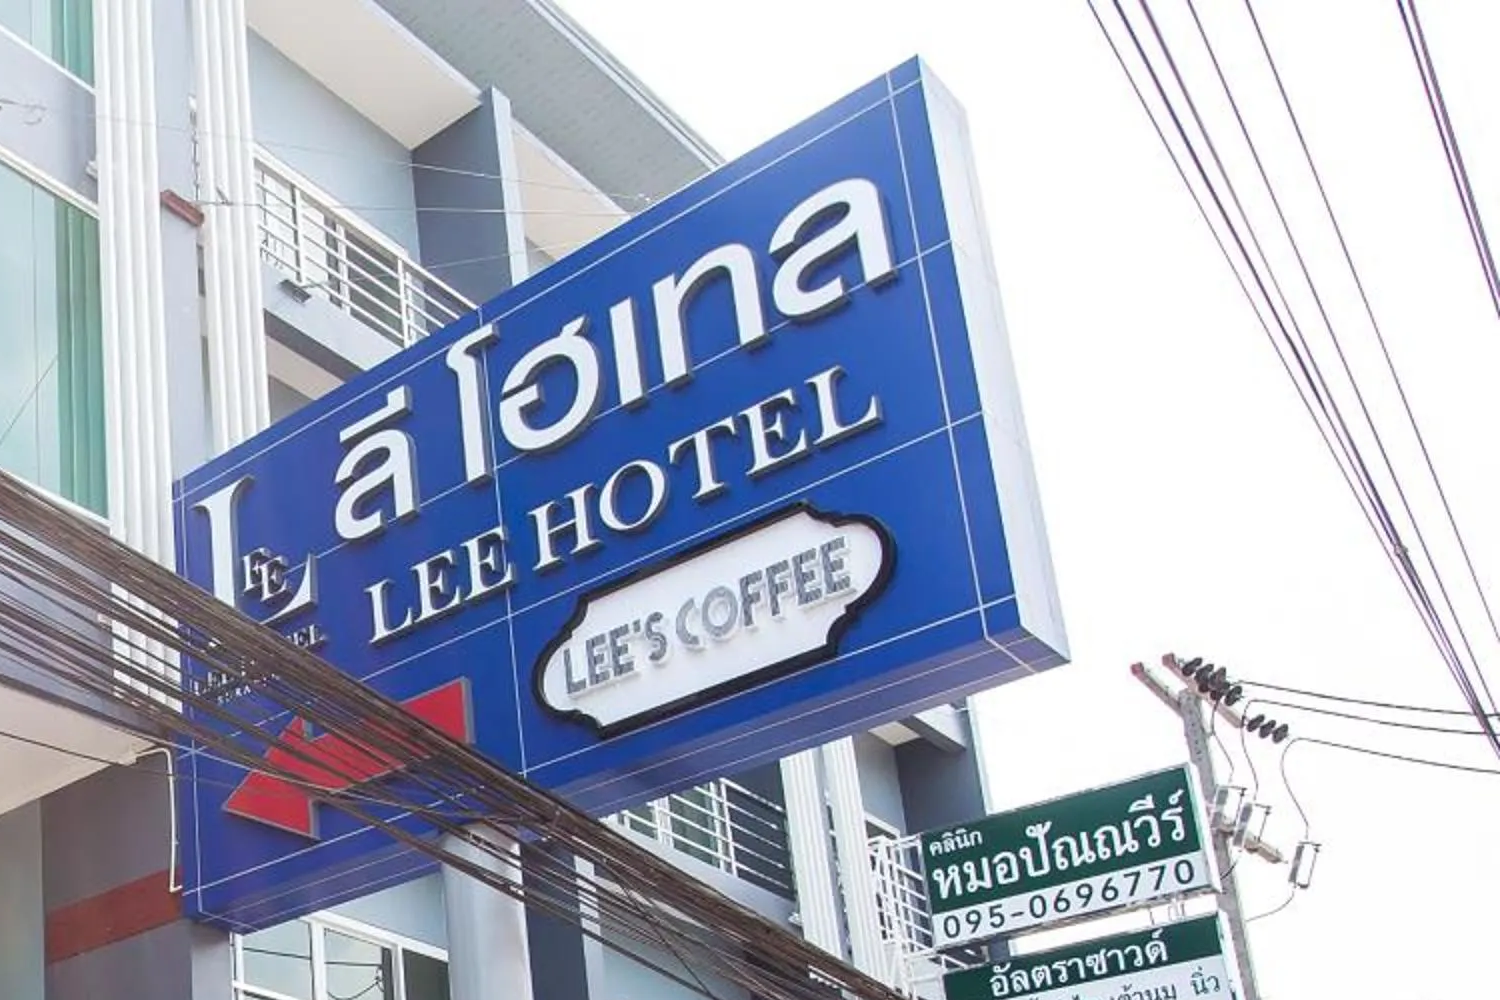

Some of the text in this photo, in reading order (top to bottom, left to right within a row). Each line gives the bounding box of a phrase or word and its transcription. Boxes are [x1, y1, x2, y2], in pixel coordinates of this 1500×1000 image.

[364, 364, 885, 645] LEE HOTEL
[562, 537, 856, 697] LEE'S COFFEE
[928, 828, 983, 857] คลินิก
[932, 788, 1186, 900] หมอปัณณวีร์
[942, 858, 1195, 939] 095-0696770
[989, 928, 1170, 998] อัลตราซาวด์
[1191, 966, 1222, 996] นิ่ว
